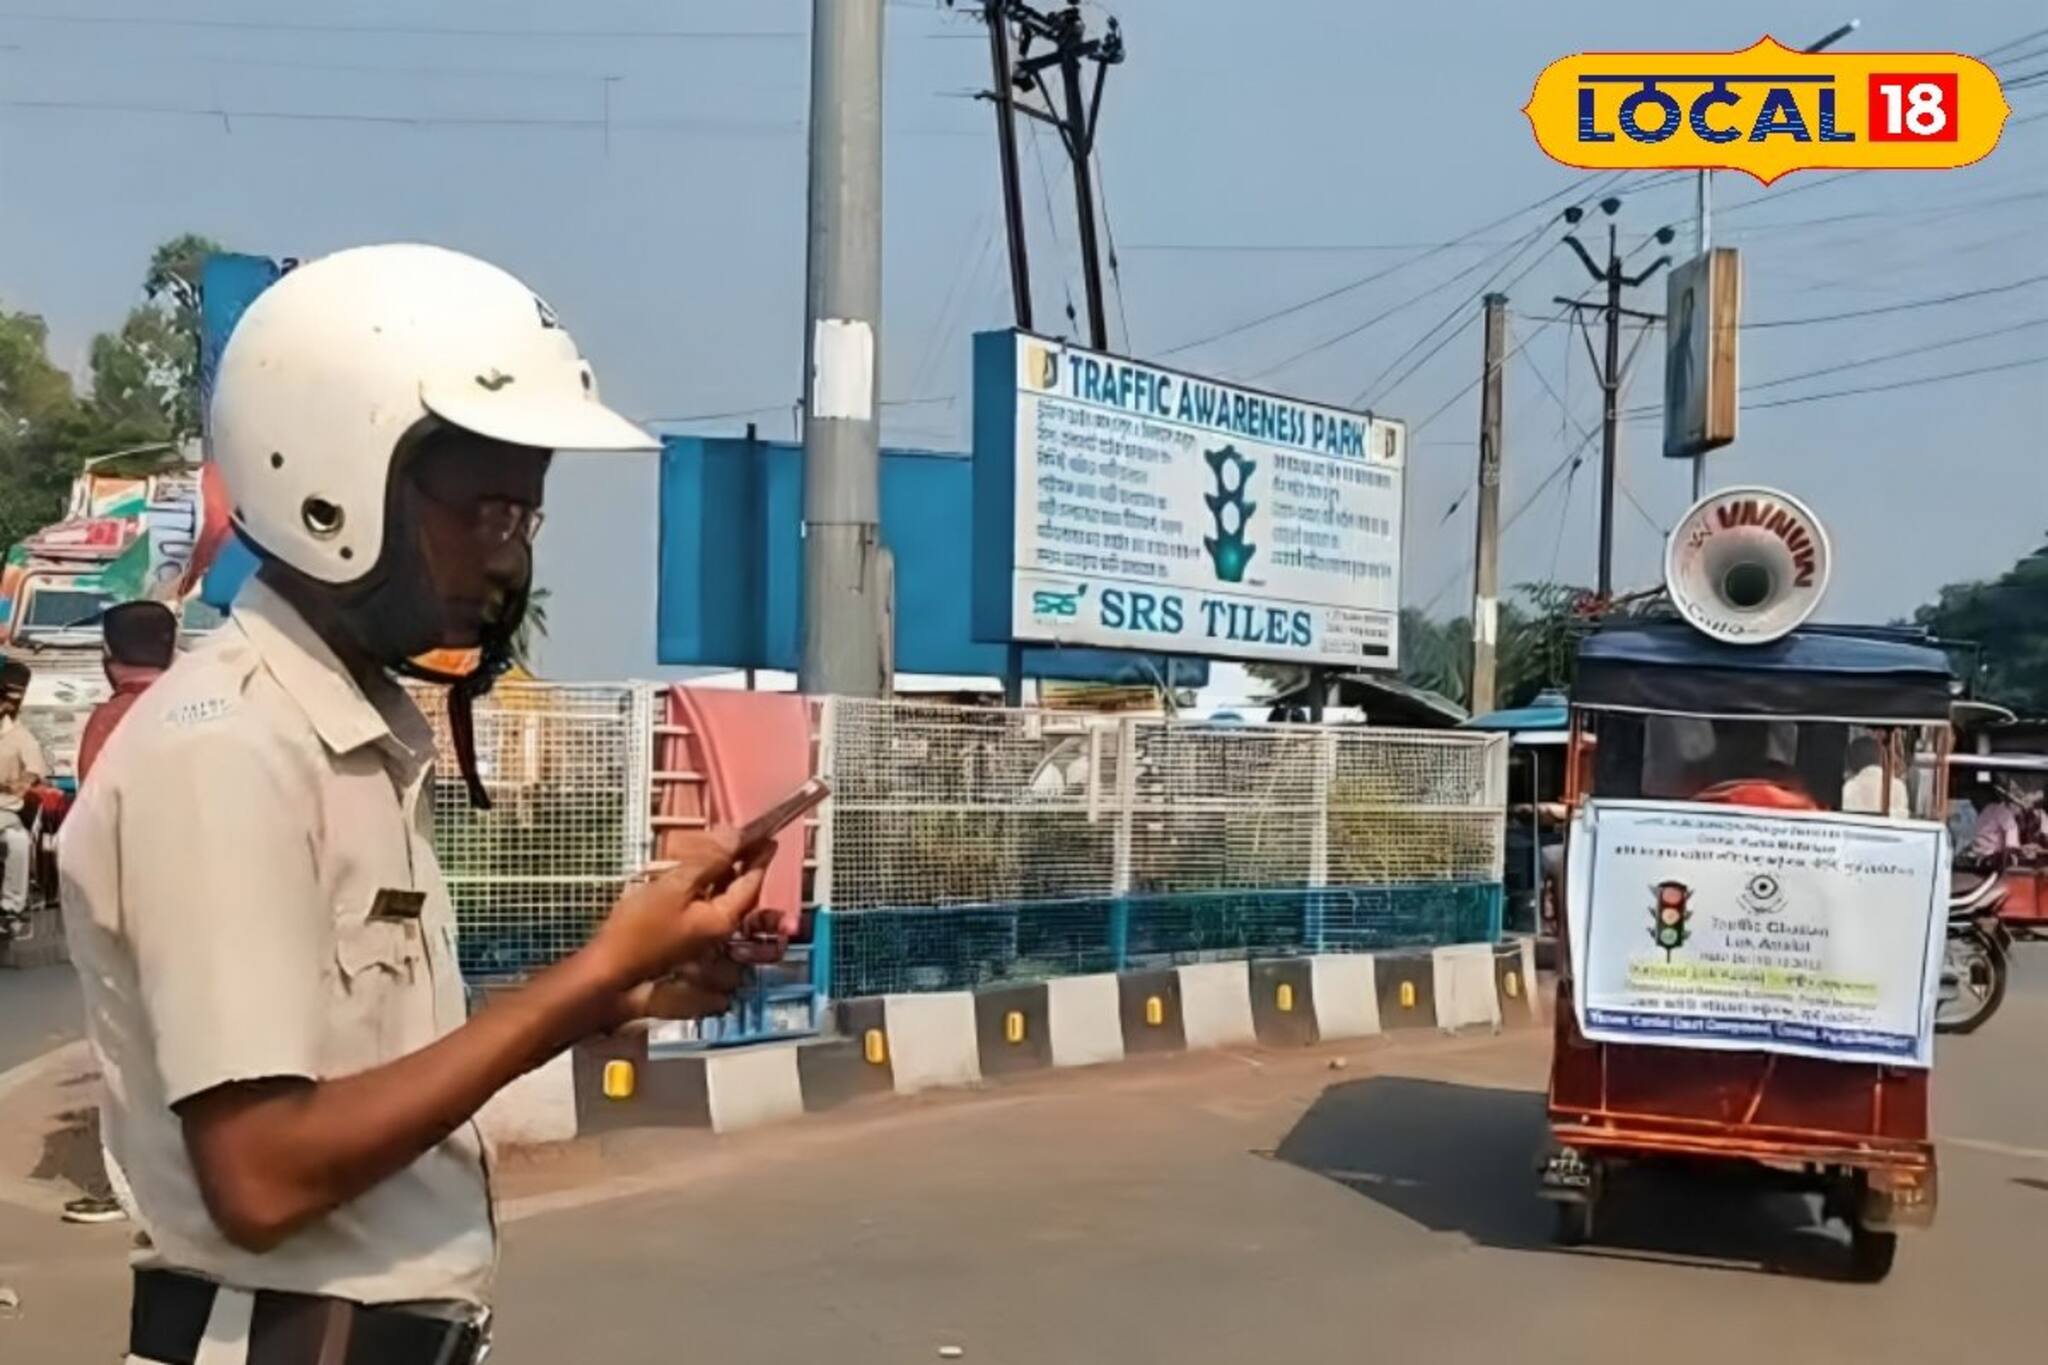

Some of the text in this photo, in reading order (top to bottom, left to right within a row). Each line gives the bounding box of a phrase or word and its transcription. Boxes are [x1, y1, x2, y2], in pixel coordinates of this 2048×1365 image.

[1069, 354, 1172, 416] TRAFFIC
[1176, 380, 1305, 445] AWARENESS
[1312, 414, 1367, 459] PARK
[1099, 588, 1312, 647] SRS TILES
